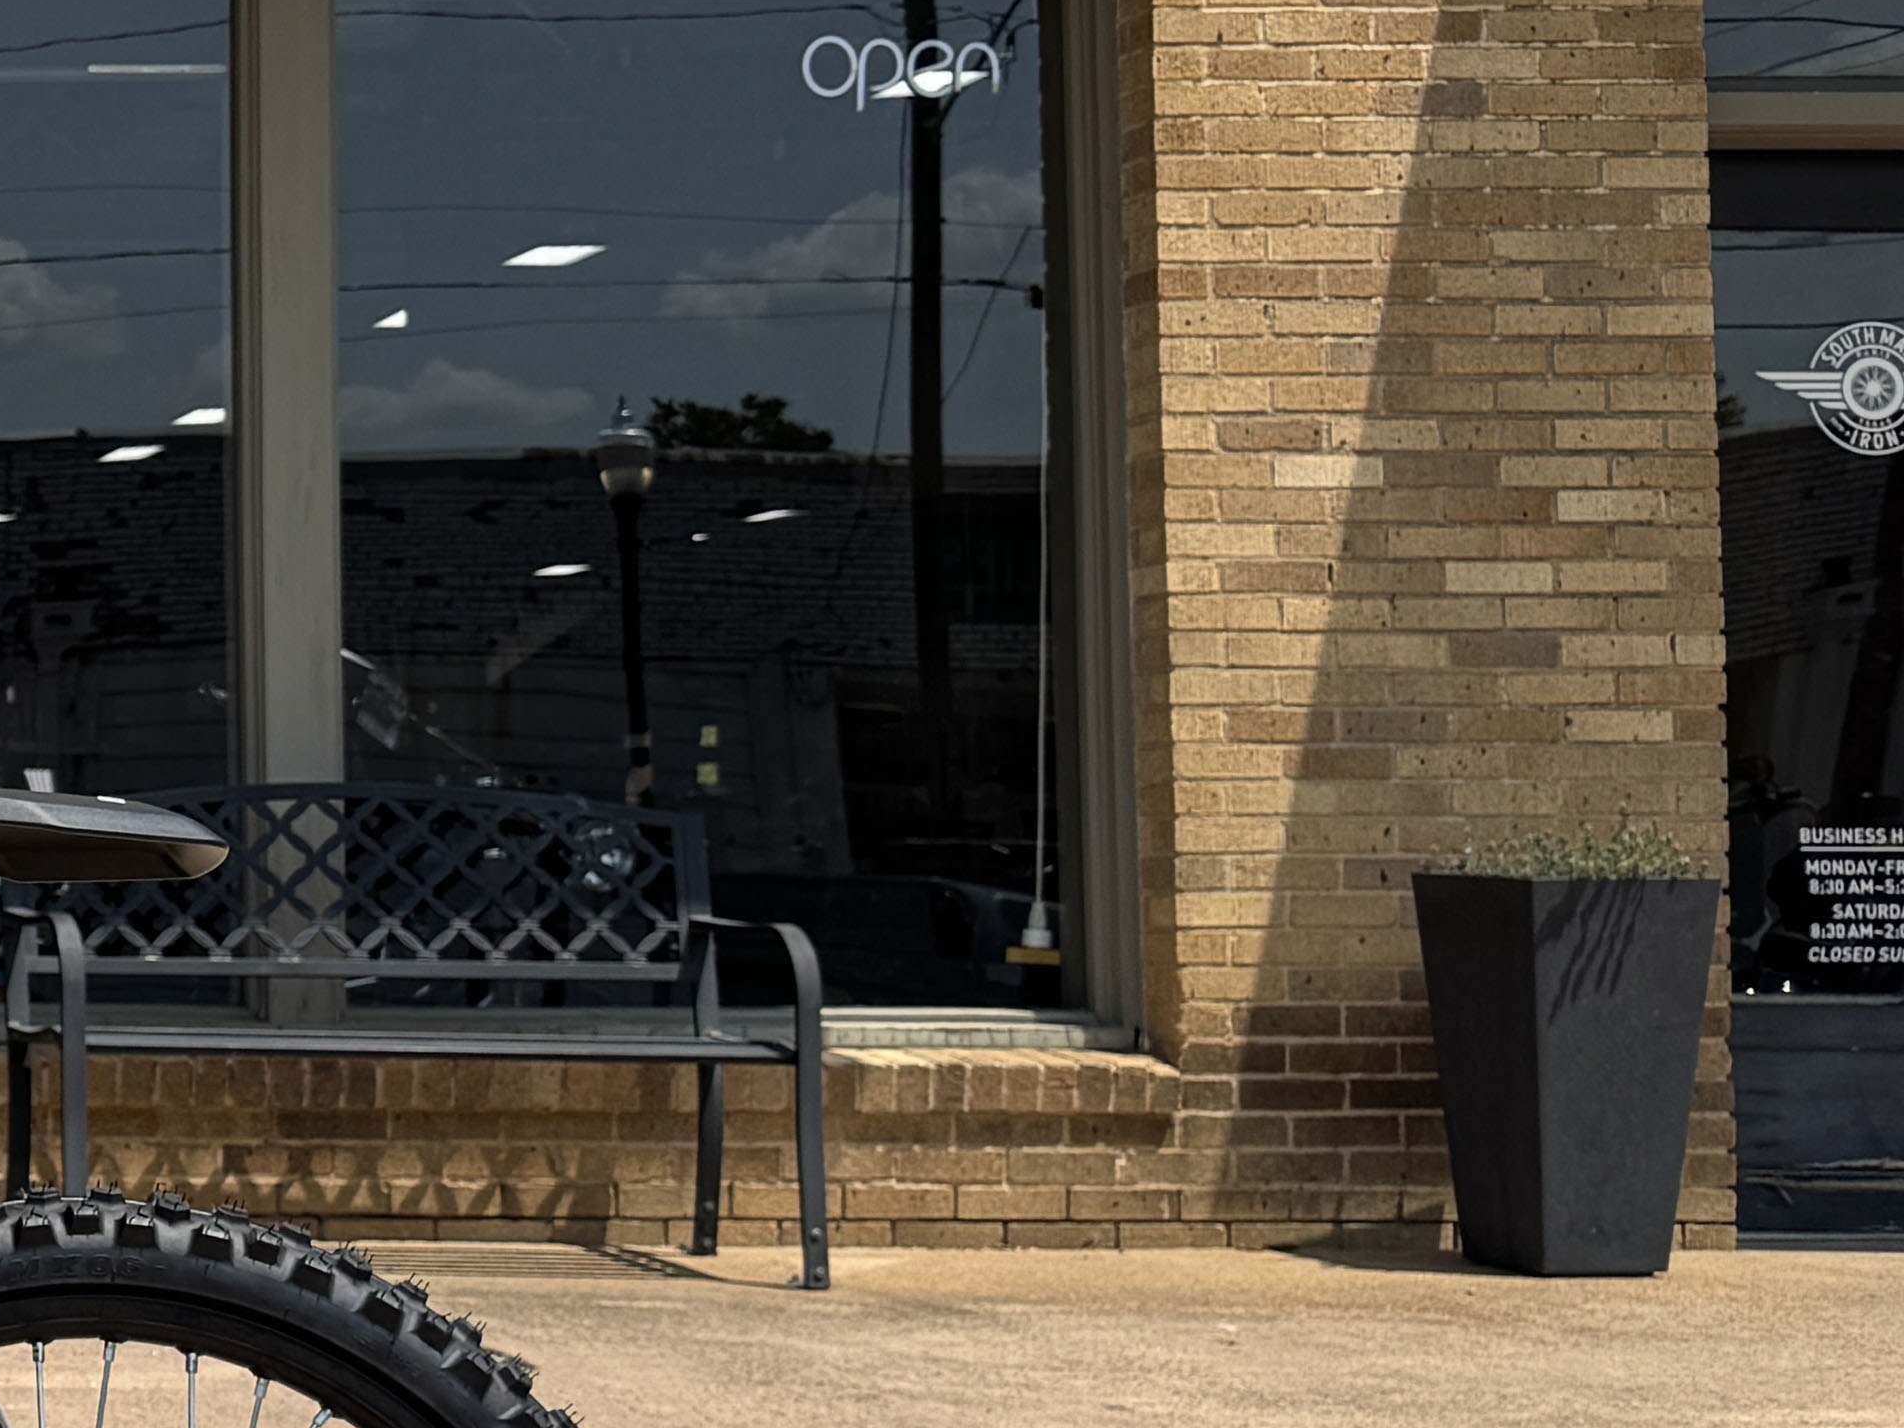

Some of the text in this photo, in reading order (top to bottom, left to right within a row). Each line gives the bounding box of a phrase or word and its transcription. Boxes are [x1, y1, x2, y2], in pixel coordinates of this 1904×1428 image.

[1821, 327, 1904, 368] SOUTH MA
[1850, 429, 1899, 449] IRON
[1800, 827, 1887, 844] BUSINESS
[1805, 859, 1904, 875] MONDAY-FR
[1808, 946, 1876, 963] CLOSED
